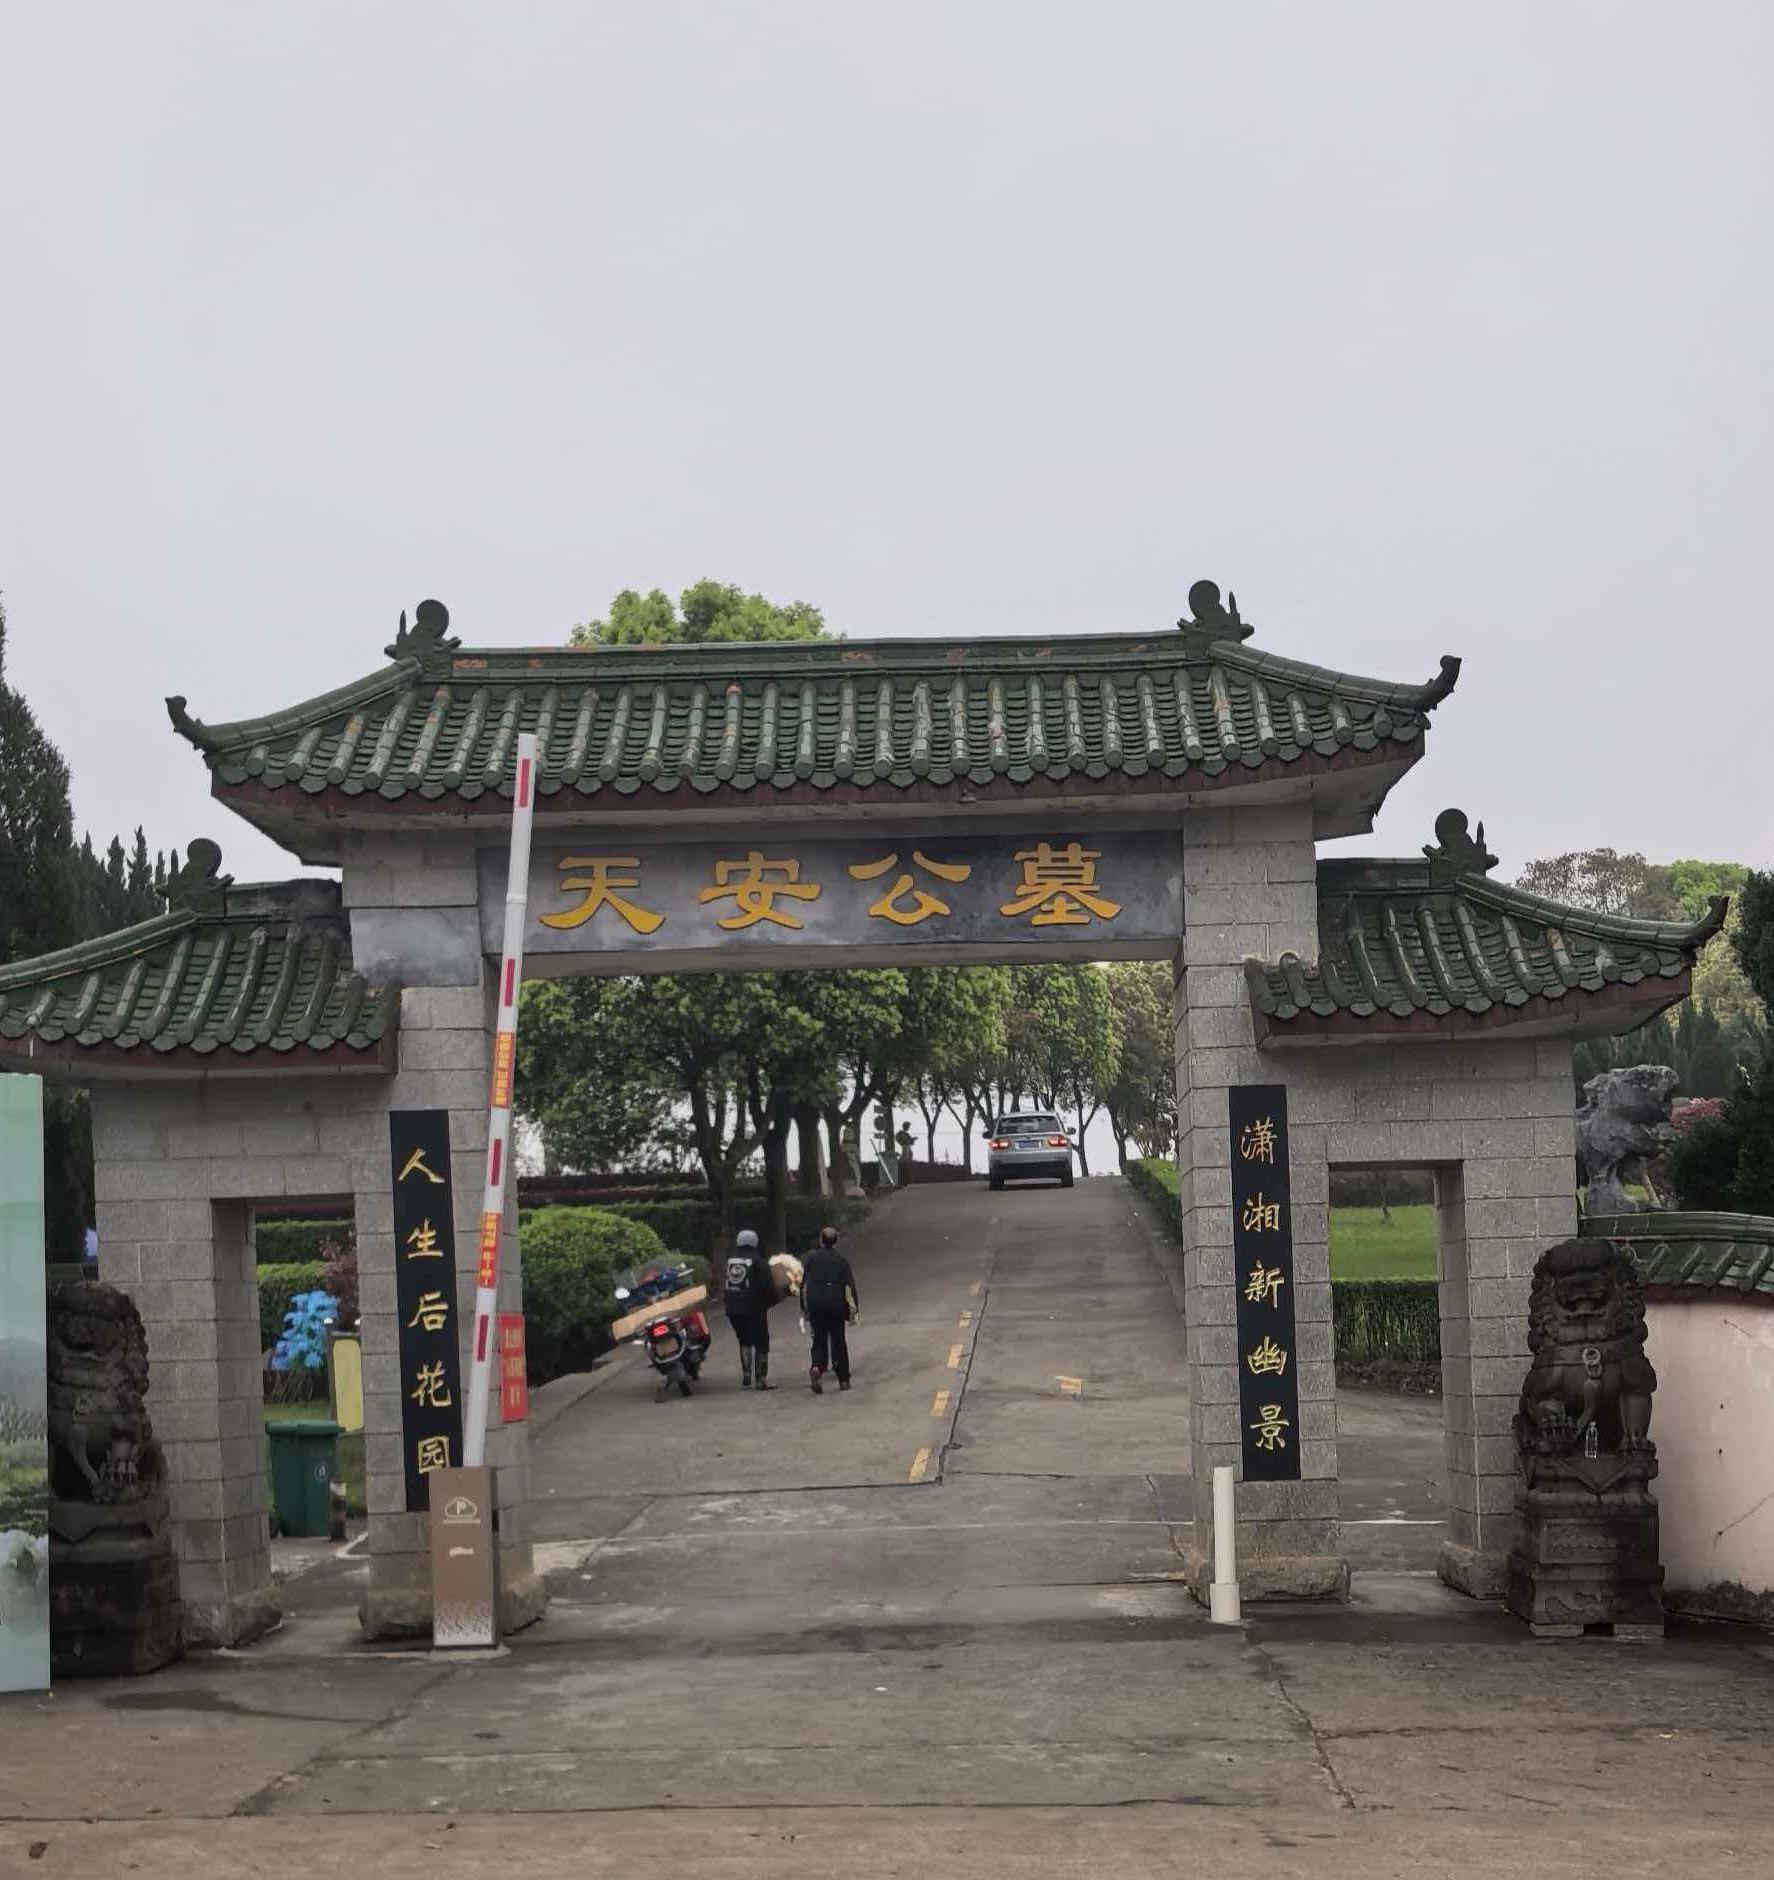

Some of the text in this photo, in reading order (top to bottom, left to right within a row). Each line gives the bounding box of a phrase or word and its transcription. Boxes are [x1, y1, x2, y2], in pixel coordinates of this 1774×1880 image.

[538, 841, 1122, 935] 天安公墓
[397, 1147, 453, 1474] 人生后花园
[1239, 1116, 1291, 1451] 潇湘新幽景
